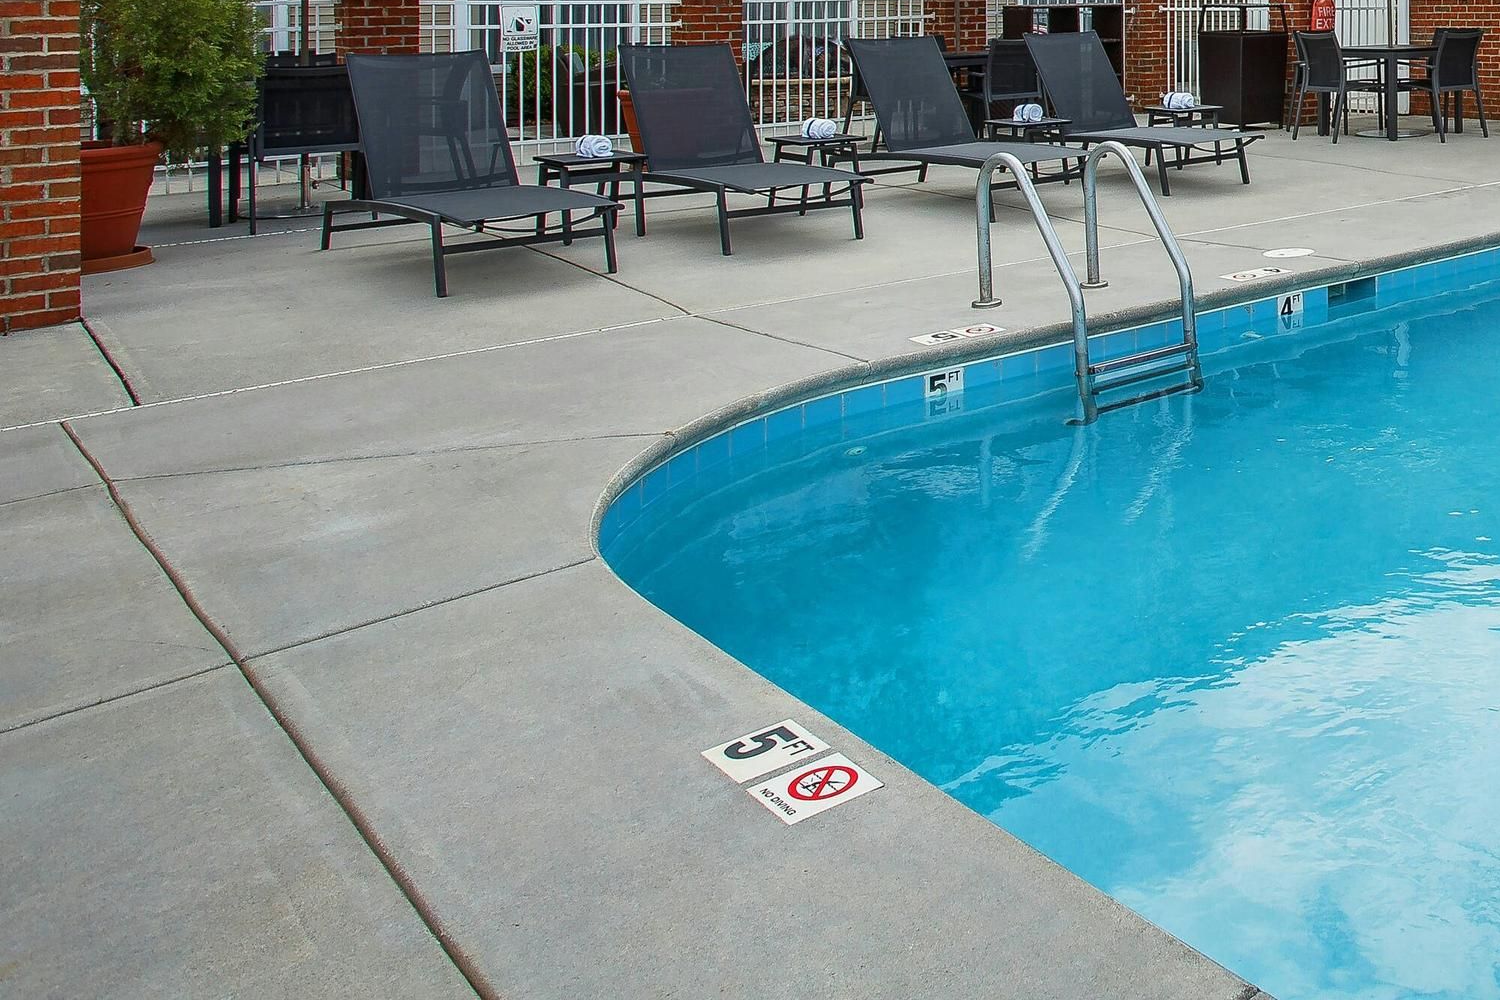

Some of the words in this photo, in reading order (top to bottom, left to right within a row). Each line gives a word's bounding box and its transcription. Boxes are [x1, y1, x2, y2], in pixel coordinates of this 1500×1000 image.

[1281, 295, 1293, 316] 4
[1292, 293, 1301, 304] FT
[930, 331, 959, 341] 5
[929, 373, 947, 397] 5
[948, 370, 960, 383] FT
[723, 725, 800, 760] 5
[782, 740, 815, 756] FT
[759, 788, 774, 798] NO
[771, 796, 797, 816] DIVING
